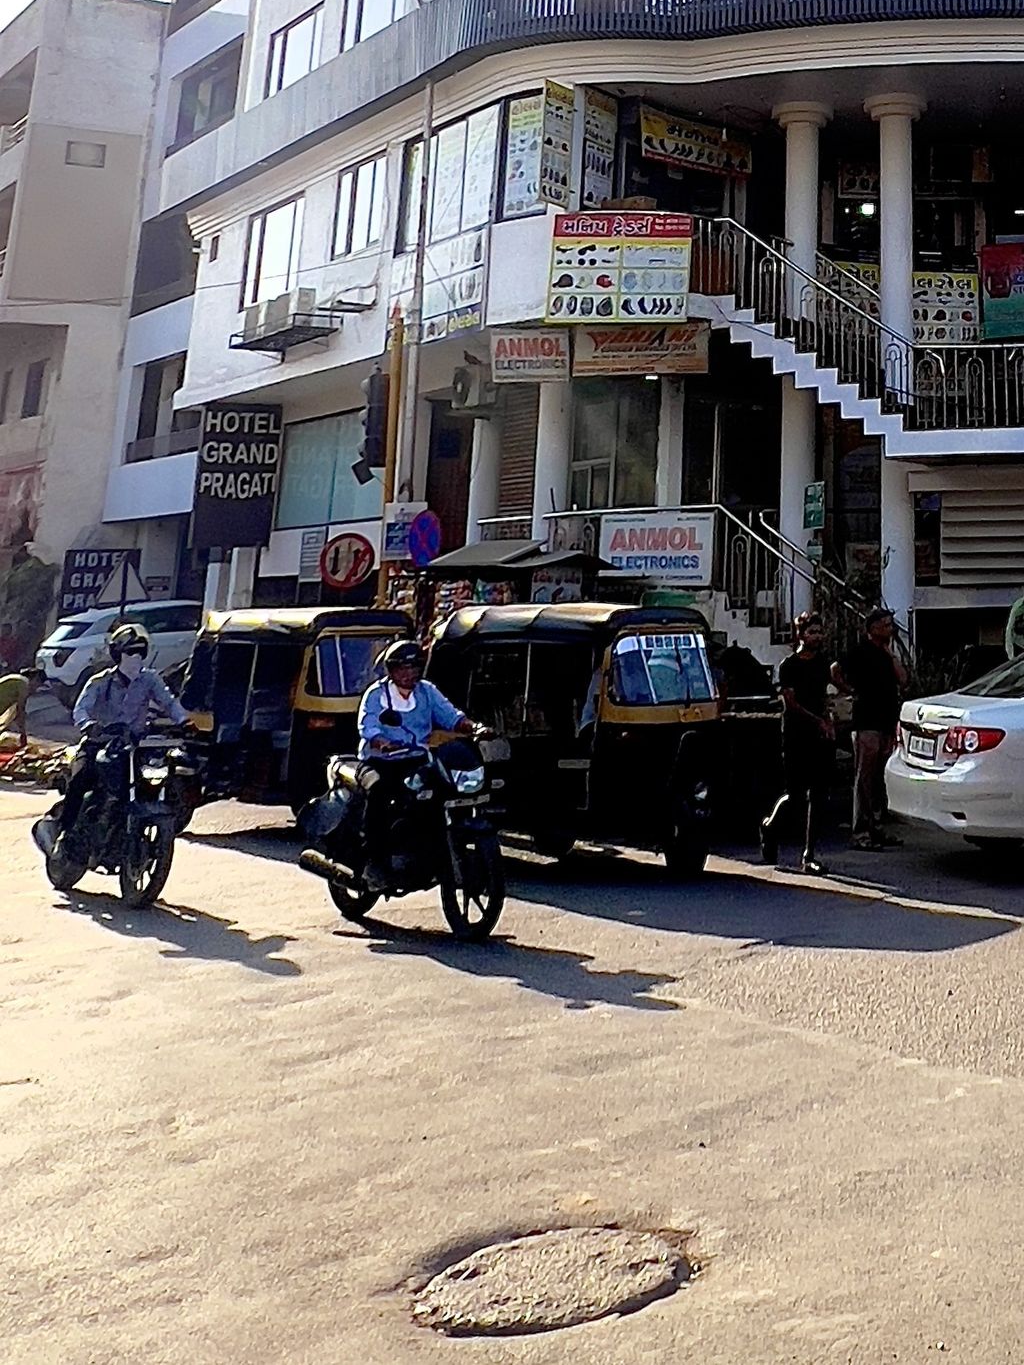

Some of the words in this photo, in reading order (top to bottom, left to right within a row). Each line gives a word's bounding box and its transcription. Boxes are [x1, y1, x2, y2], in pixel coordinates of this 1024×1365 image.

[495, 337, 567, 358] ANMOL
[495, 359, 567, 371] ELECTRONICS
[205, 411, 282, 434] HOTEL
[202, 440, 279, 465] GRAND
[198, 472, 276, 500] PRAGATI
[609, 526, 703, 552] ANMOL
[74, 552, 122, 568] HOTE
[611, 555, 699, 571] ELECTRONICS
